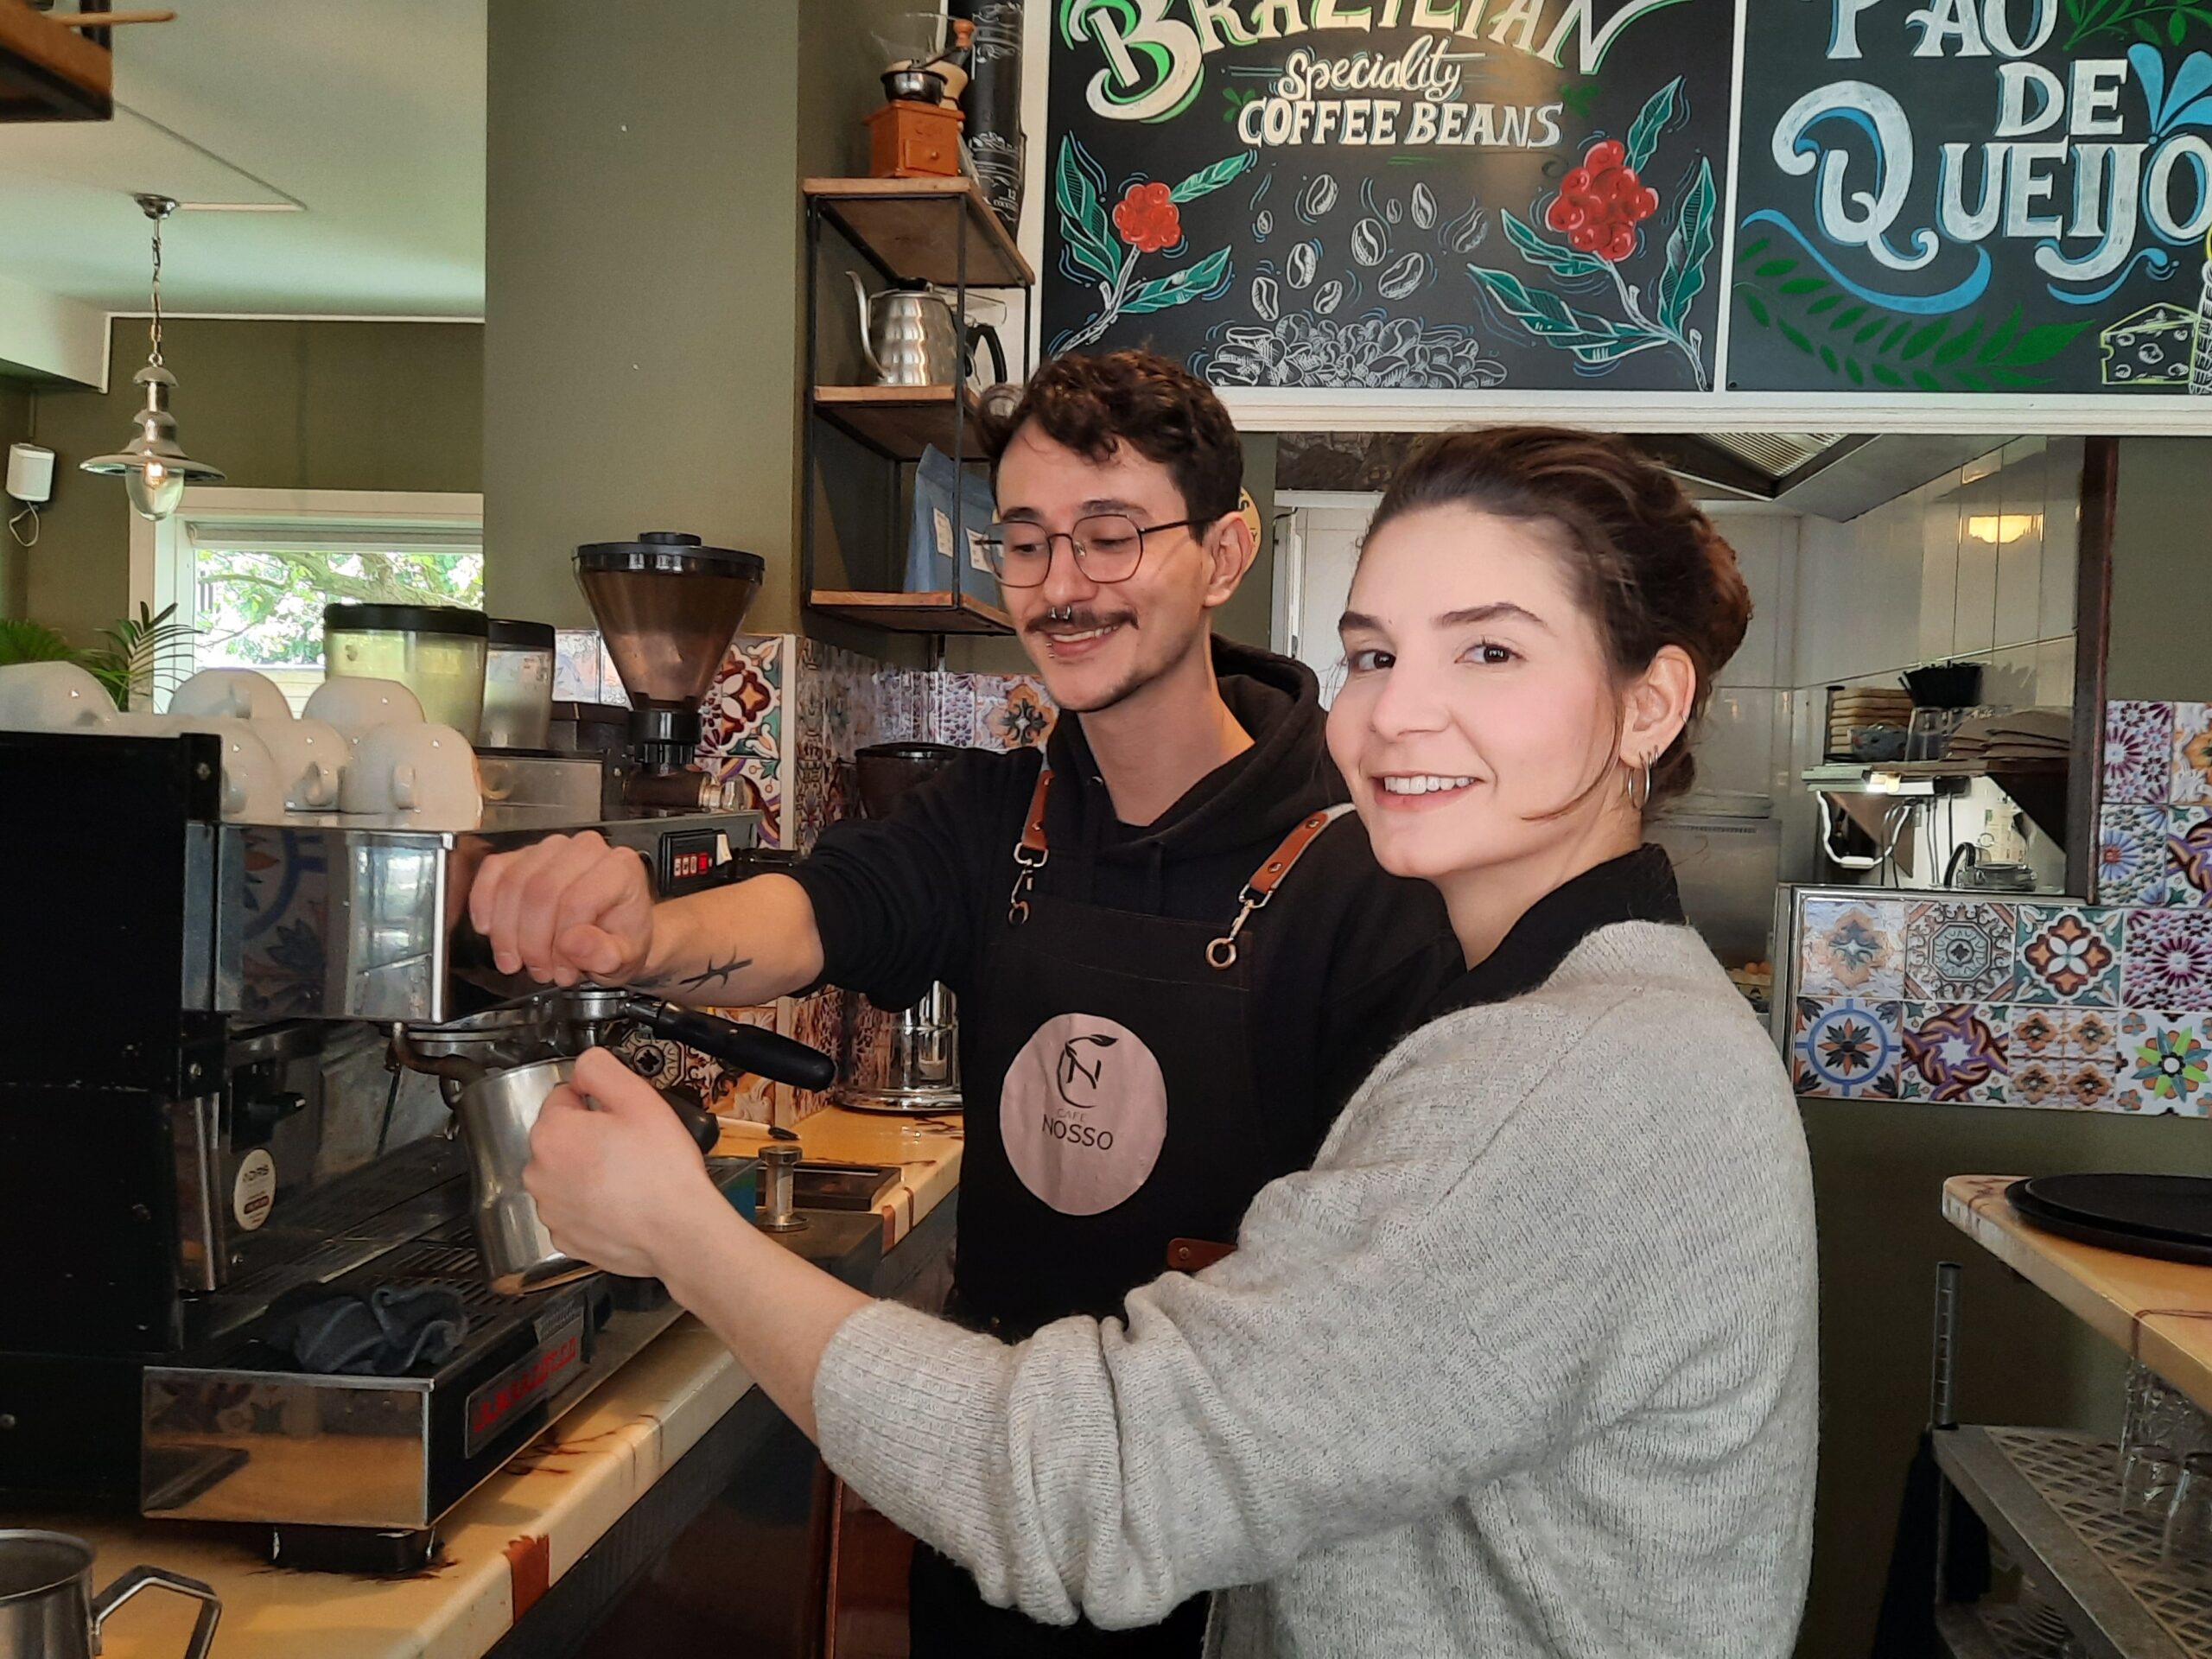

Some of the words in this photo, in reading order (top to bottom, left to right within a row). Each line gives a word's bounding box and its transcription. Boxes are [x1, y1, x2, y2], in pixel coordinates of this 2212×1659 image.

[1278, 36, 1484, 102] Speciality
[1994, 60, 2127, 137] DE
[1238, 97, 1401, 148] COFFEE
[1404, 101, 1563, 149] BEANS
[1772, 80, 2211, 281] QUEIJO
[1042, 1114, 1113, 1150] NOSSO
